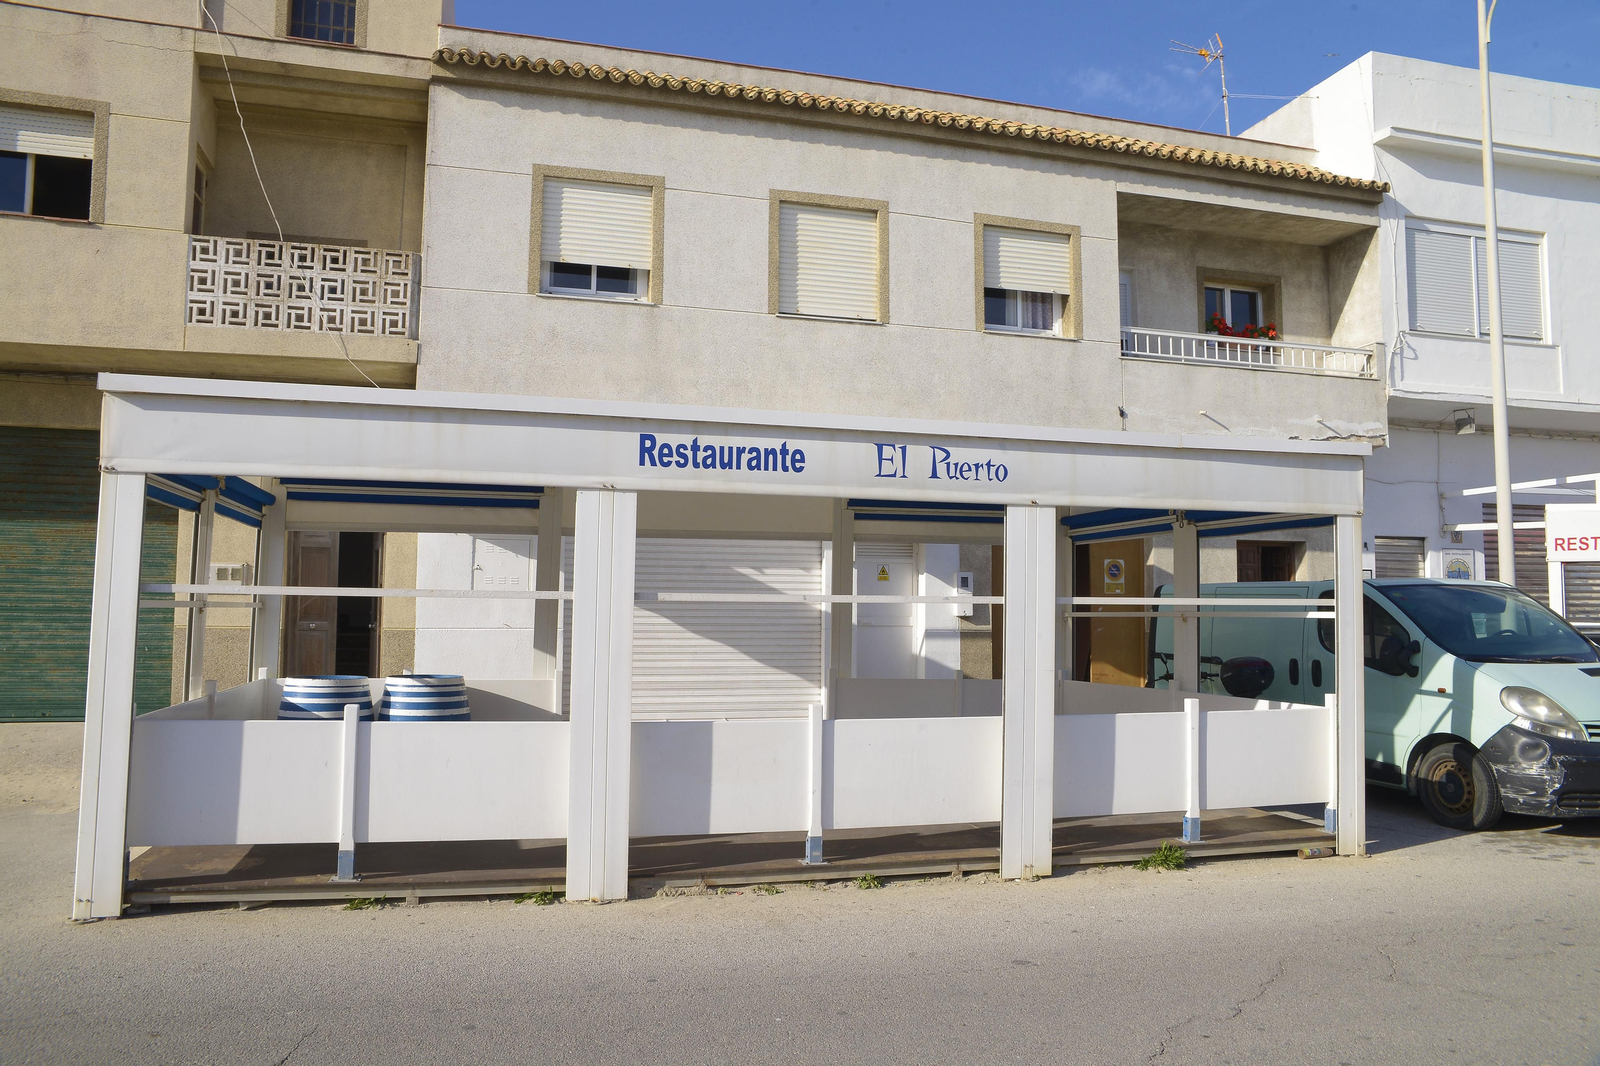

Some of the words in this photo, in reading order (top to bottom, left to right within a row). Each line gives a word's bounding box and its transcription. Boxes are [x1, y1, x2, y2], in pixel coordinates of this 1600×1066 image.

[639, 433, 806, 473] Restaurante
[873, 443, 908, 479] El
[928, 445, 1009, 483] Puerto
[1554, 536, 1600, 551] REST
